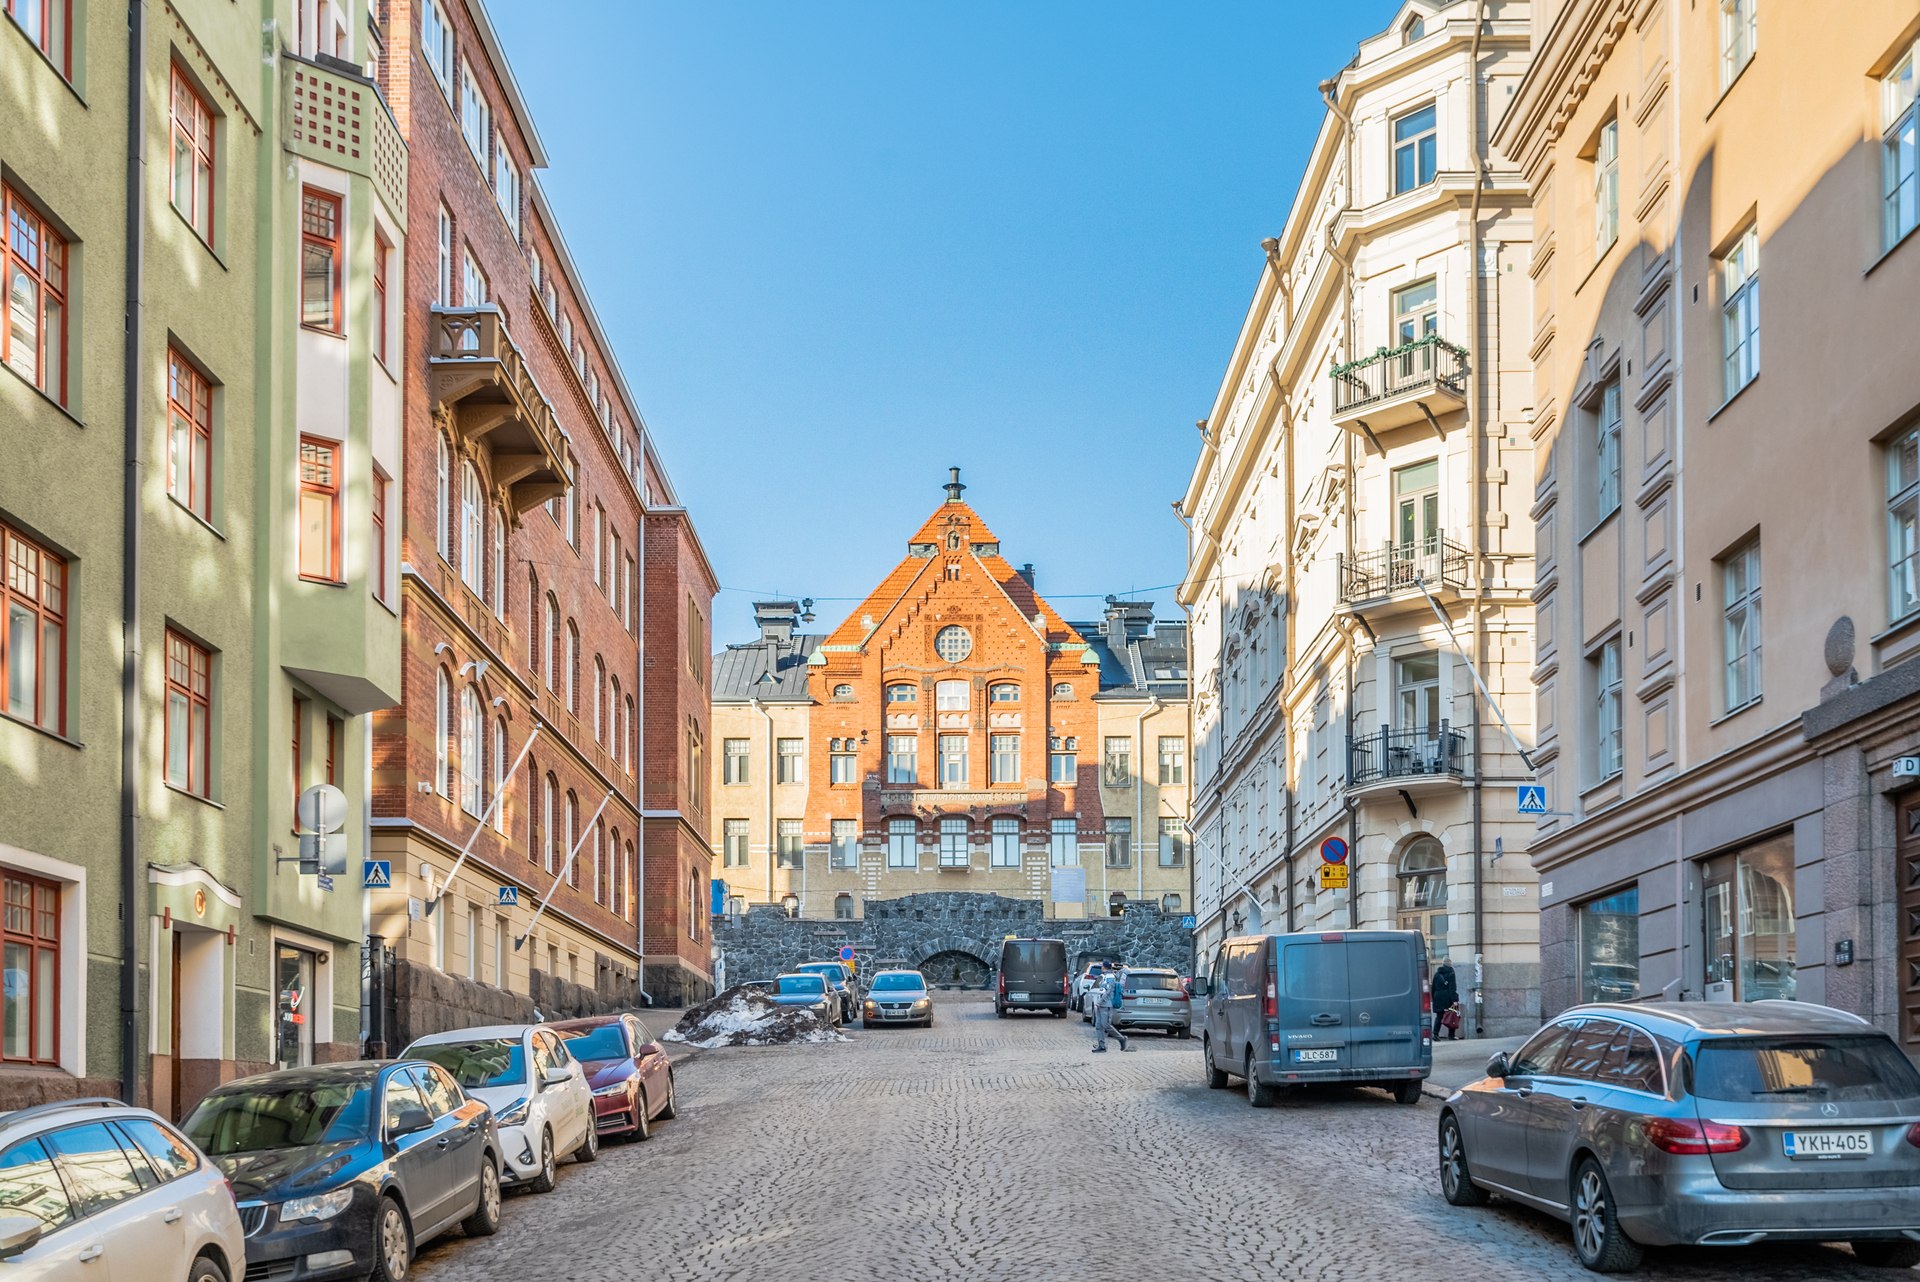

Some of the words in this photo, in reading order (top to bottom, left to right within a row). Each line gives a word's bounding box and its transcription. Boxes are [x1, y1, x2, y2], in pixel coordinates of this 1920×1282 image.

[1906, 759, 1914, 772] D
[1302, 1051, 1335, 1060] JLC-587
[1798, 1135, 1868, 1151] YKH-405
